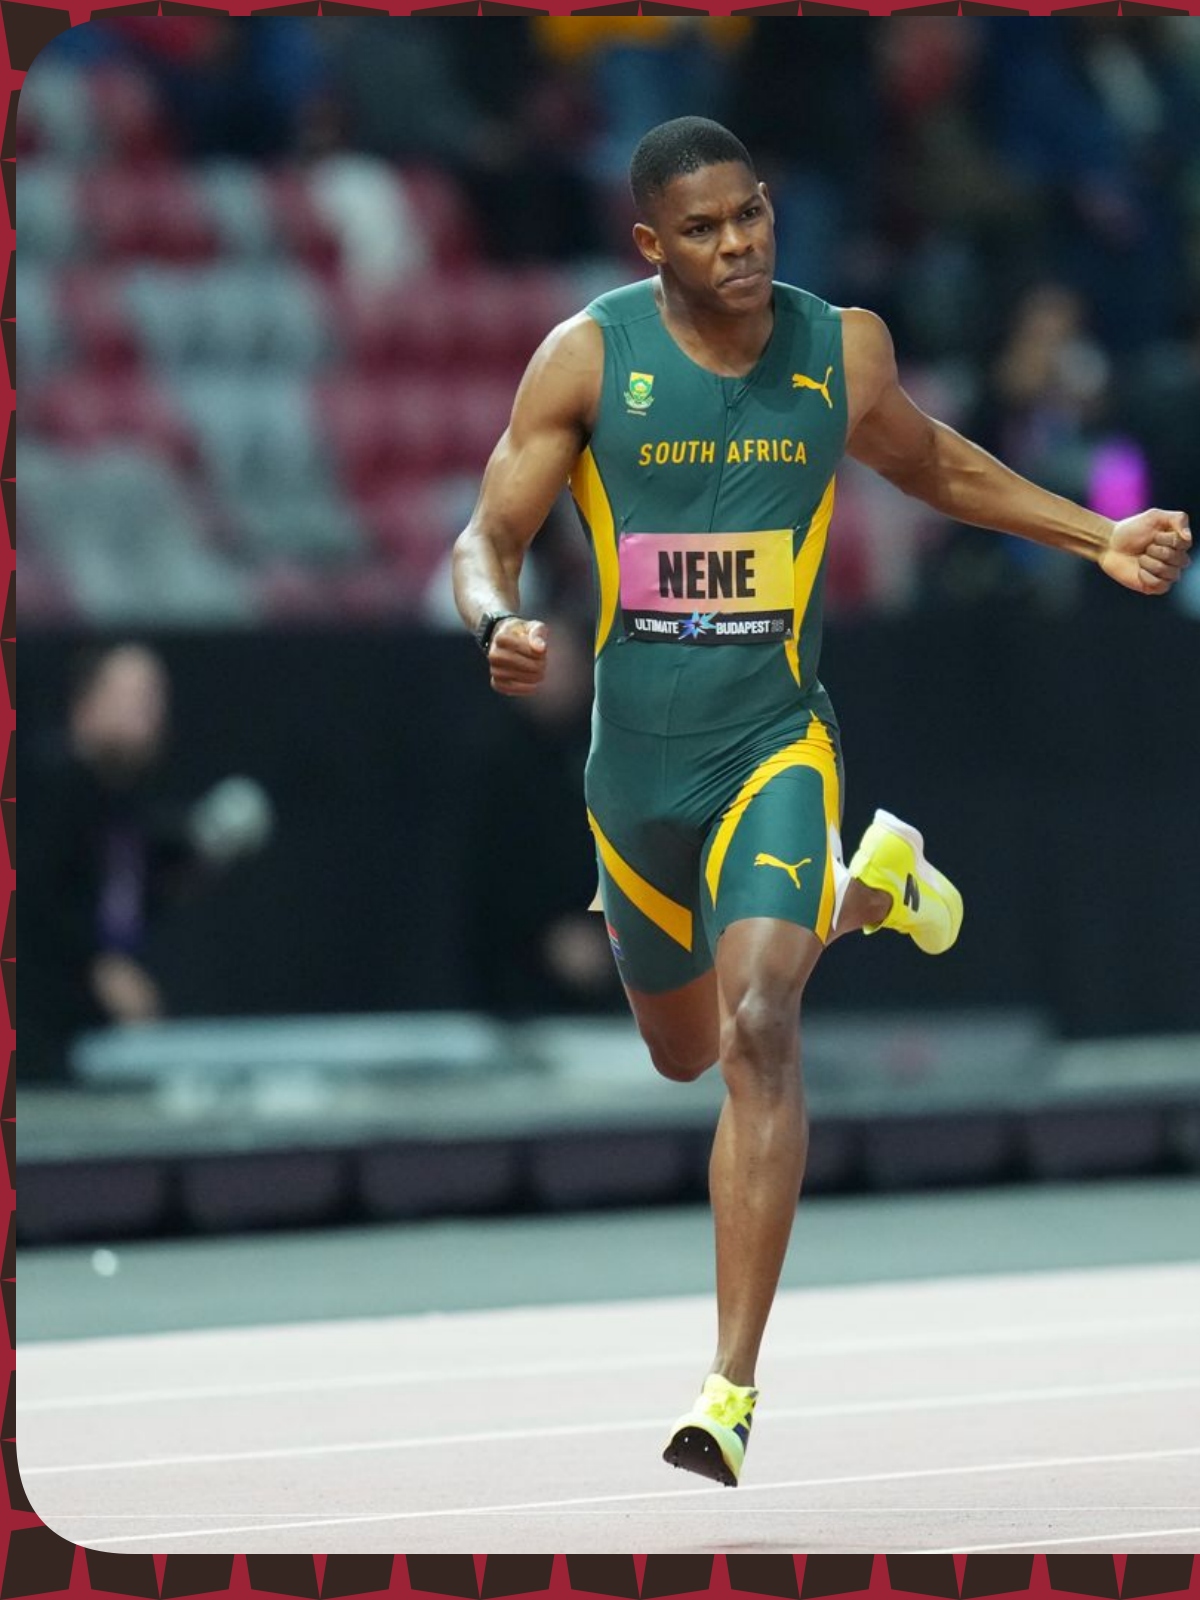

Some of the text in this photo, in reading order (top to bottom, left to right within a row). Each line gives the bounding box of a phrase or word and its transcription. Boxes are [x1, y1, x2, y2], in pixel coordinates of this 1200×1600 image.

[638, 439, 807, 467] SOUTH AFRICA
[658, 550, 756, 599] NENE
[634, 618, 680, 634] ULTIMATE
[716, 620, 770, 635] BUDAPEST
